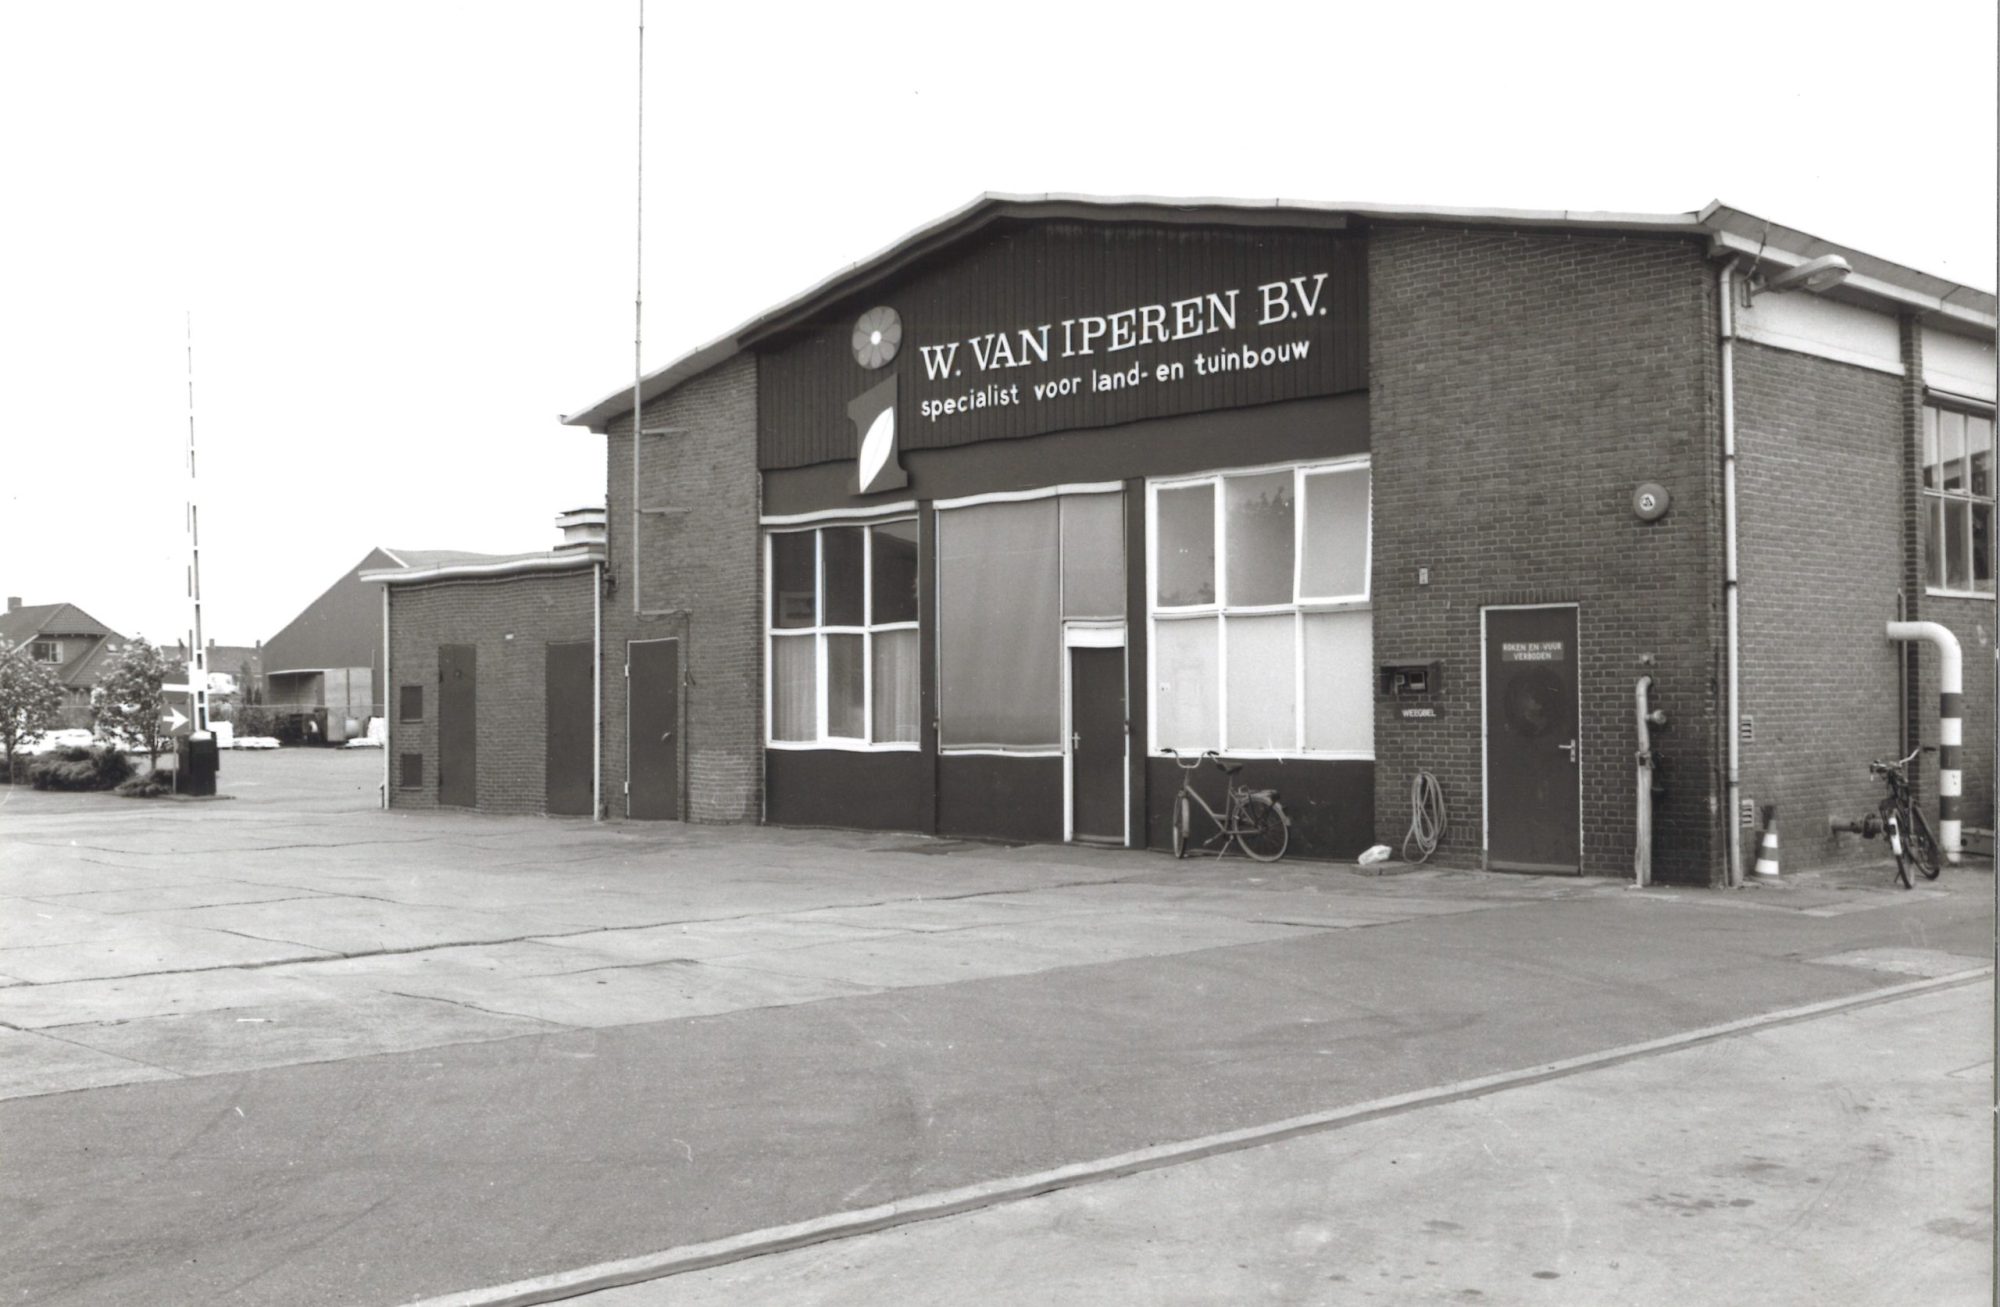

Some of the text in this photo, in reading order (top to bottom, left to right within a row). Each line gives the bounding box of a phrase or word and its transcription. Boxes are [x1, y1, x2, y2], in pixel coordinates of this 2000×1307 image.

[920, 273, 1328, 381] W. VAN IPEREN B.V.
[921, 340, 1310, 421] specialist voor land- en tuinbouw
[1513, 652, 1552, 660] VERBODEN
[1529, 642, 1540, 651] EN
